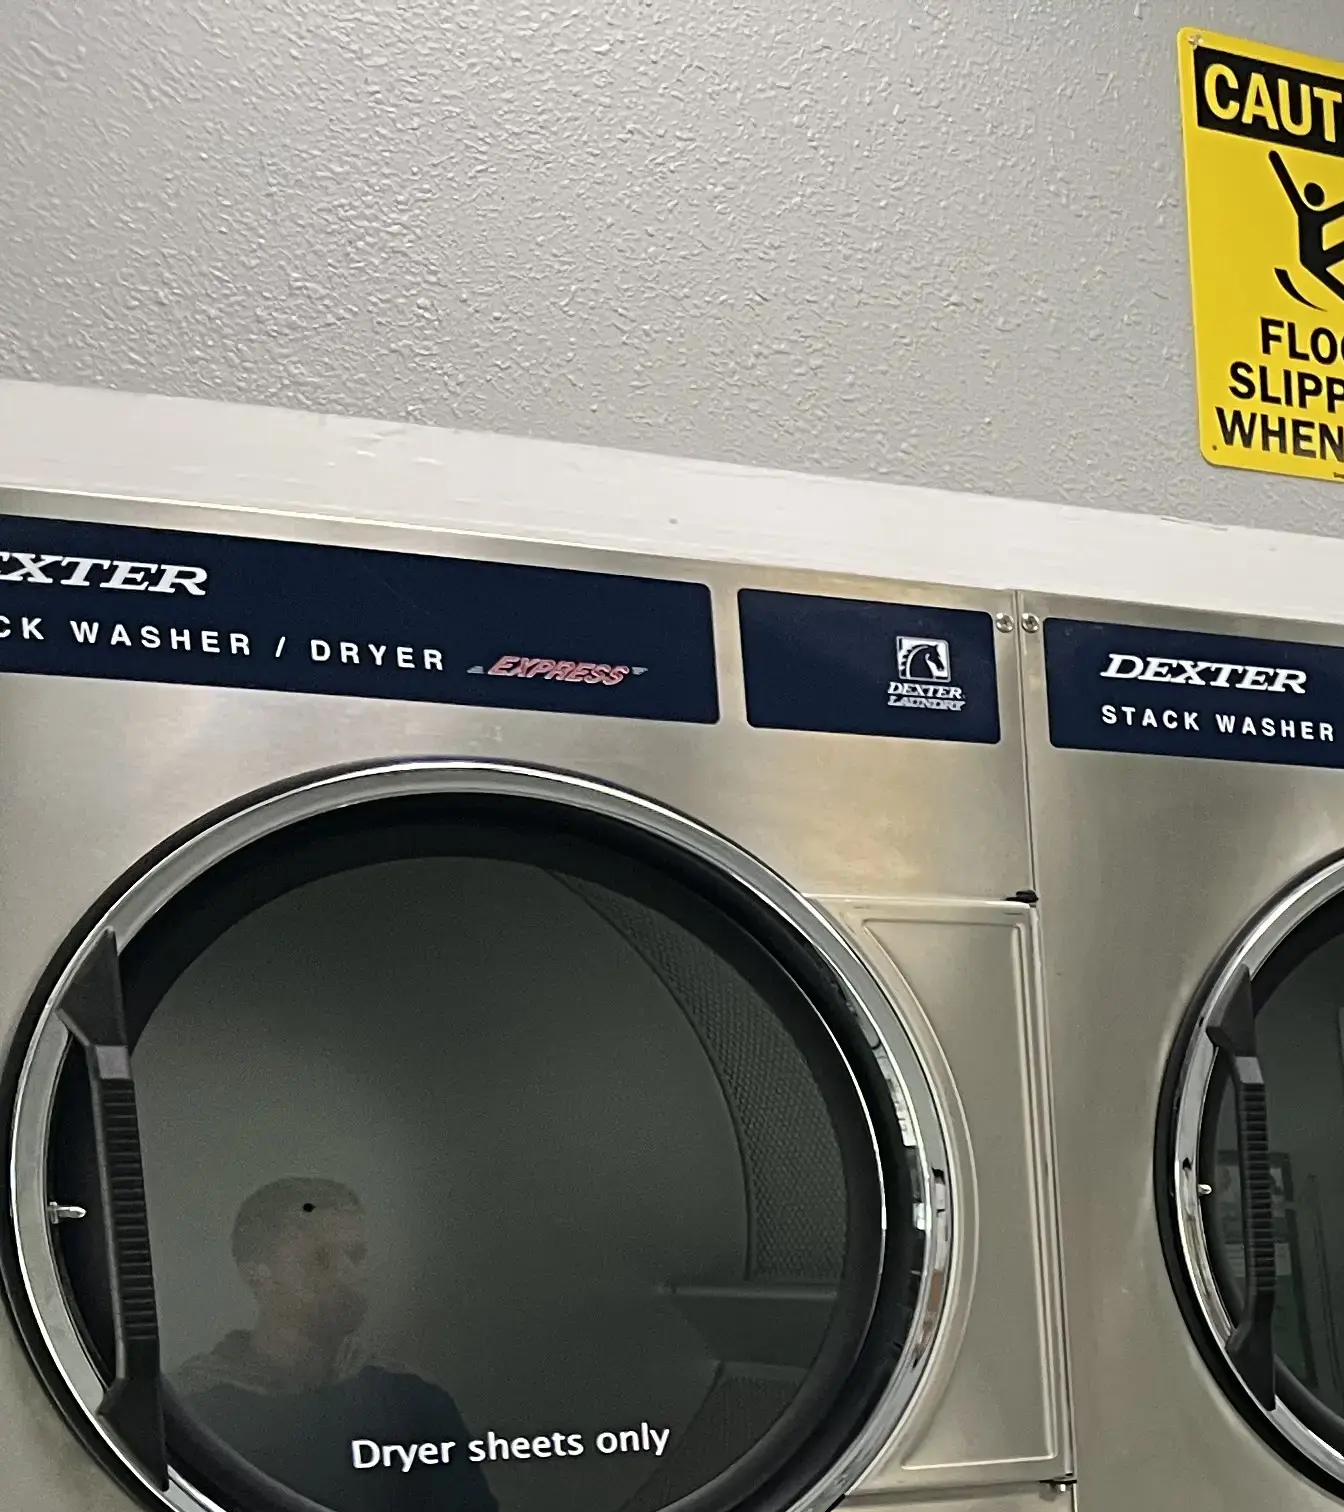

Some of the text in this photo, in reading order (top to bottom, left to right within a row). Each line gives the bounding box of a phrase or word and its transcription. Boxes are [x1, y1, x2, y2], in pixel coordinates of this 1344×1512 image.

[70, 619, 250, 655] WASHER
[274, 635, 288, 658] /
[310, 638, 445, 672] DRYER
[487, 654, 633, 687] EXPRESS
[887, 681, 963, 699] DEXTER
[1100, 653, 1308, 694] DEXTER
[1101, 705, 1200, 733] STACK
[1215, 713, 1335, 743] WASHER
[351, 1422, 670, 1473] Dryer sheets only
